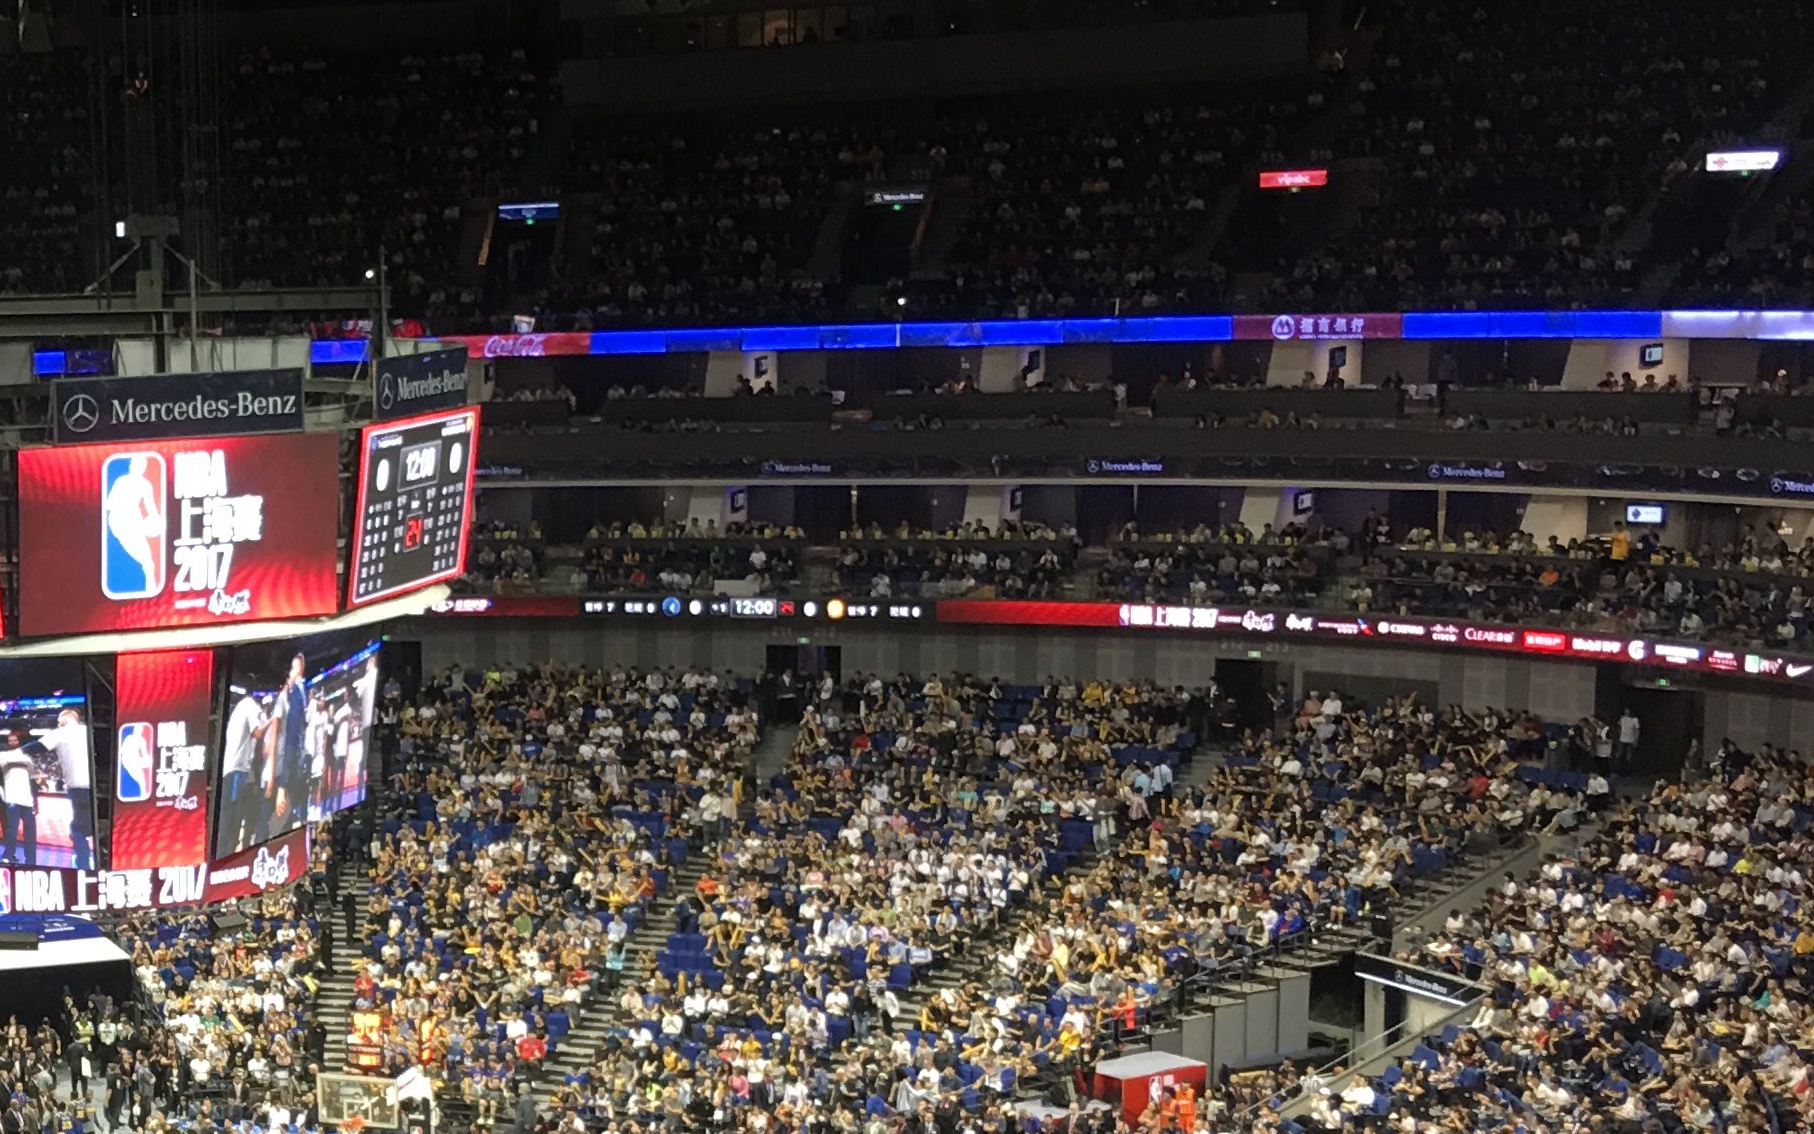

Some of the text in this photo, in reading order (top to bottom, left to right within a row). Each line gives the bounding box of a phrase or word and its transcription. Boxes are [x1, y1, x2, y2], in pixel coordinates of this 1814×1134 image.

[110, 392, 296, 425] Mercedes-Benz
[1443, 466, 1506, 479] Mercedes-Benz
[173, 543, 234, 592] 2017
[736, 601, 774, 615] 12:00
[14, 869, 65, 911] NBA
[70, 867, 154, 911] 上海赛
[158, 862, 208, 905] 2017
